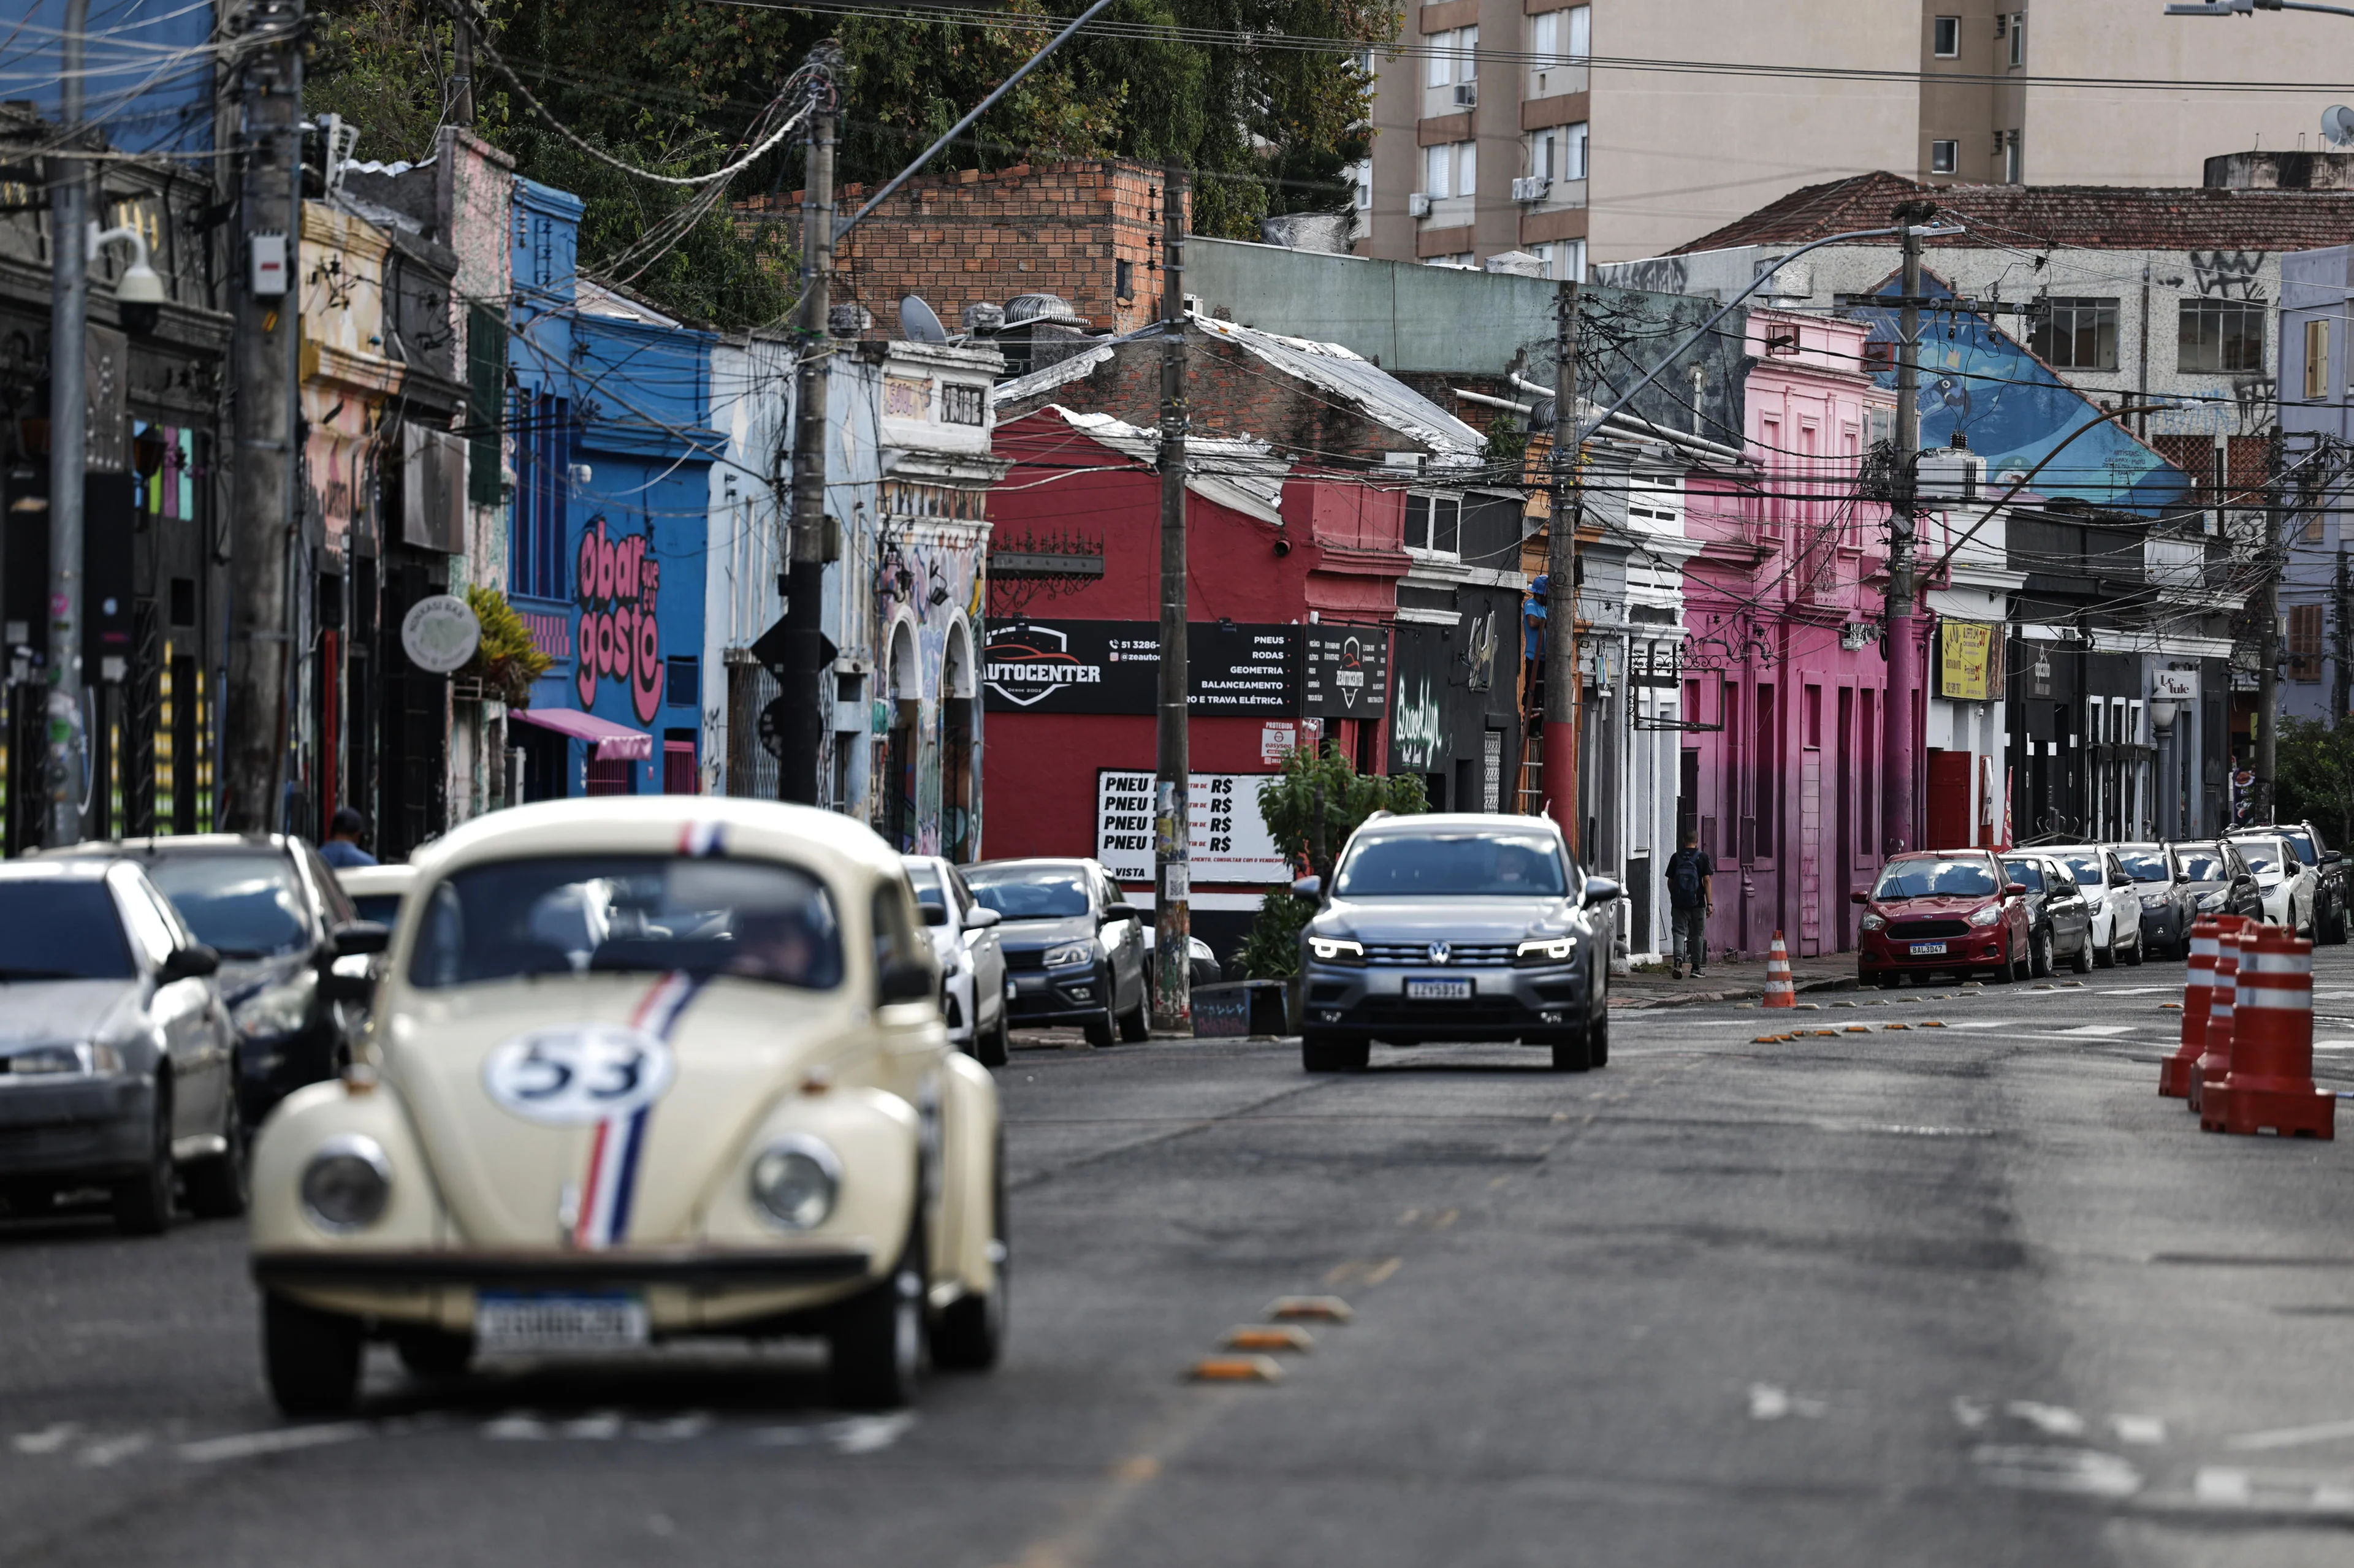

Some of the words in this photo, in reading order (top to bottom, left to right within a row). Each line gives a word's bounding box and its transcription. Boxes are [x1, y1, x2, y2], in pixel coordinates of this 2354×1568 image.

[1254, 636, 1284, 644] PNEUS
[579, 604, 665, 722] gosto
[1252, 651, 1284, 660] RODAS
[1230, 666, 1284, 674] GEOMETRIA
[1201, 680, 1284, 690] BALANCEAMENTO
[2160, 674, 2174, 687] Le
[1207, 696, 1238, 704] TRAVA
[1239, 695, 1284, 705] ELÉTRICA
[1395, 674, 1442, 769] Brooklyn
[1105, 777, 1149, 792] PNEU
[1210, 778, 1233, 794] R$
[1104, 796, 1148, 811] PNEU
[1210, 797, 1232, 814] R$
[1103, 815, 1148, 831] PNEU
[1209, 816, 1232, 833] R$
[1103, 835, 1147, 850] PNEU
[1209, 835, 1231, 853] R$
[1115, 867, 1145, 877] VISTA
[516, 1033, 647, 1101] 53
